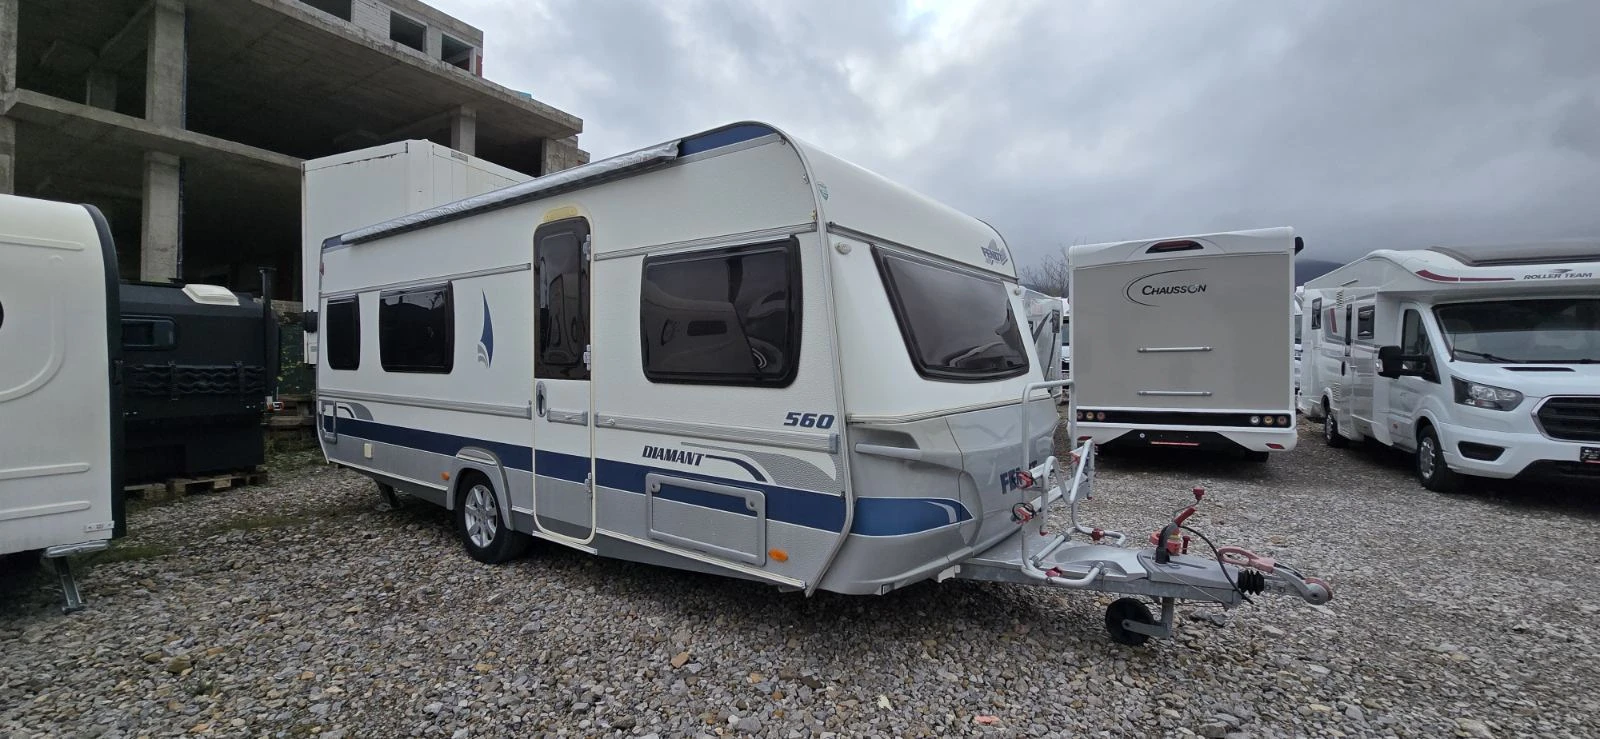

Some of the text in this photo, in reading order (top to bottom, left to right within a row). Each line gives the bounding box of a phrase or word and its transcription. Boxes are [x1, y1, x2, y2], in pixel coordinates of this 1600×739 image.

[1141, 285, 1207, 296] CHAUSSON
[783, 411, 835, 429] 560
[642, 445, 704, 467] DIAMANT
